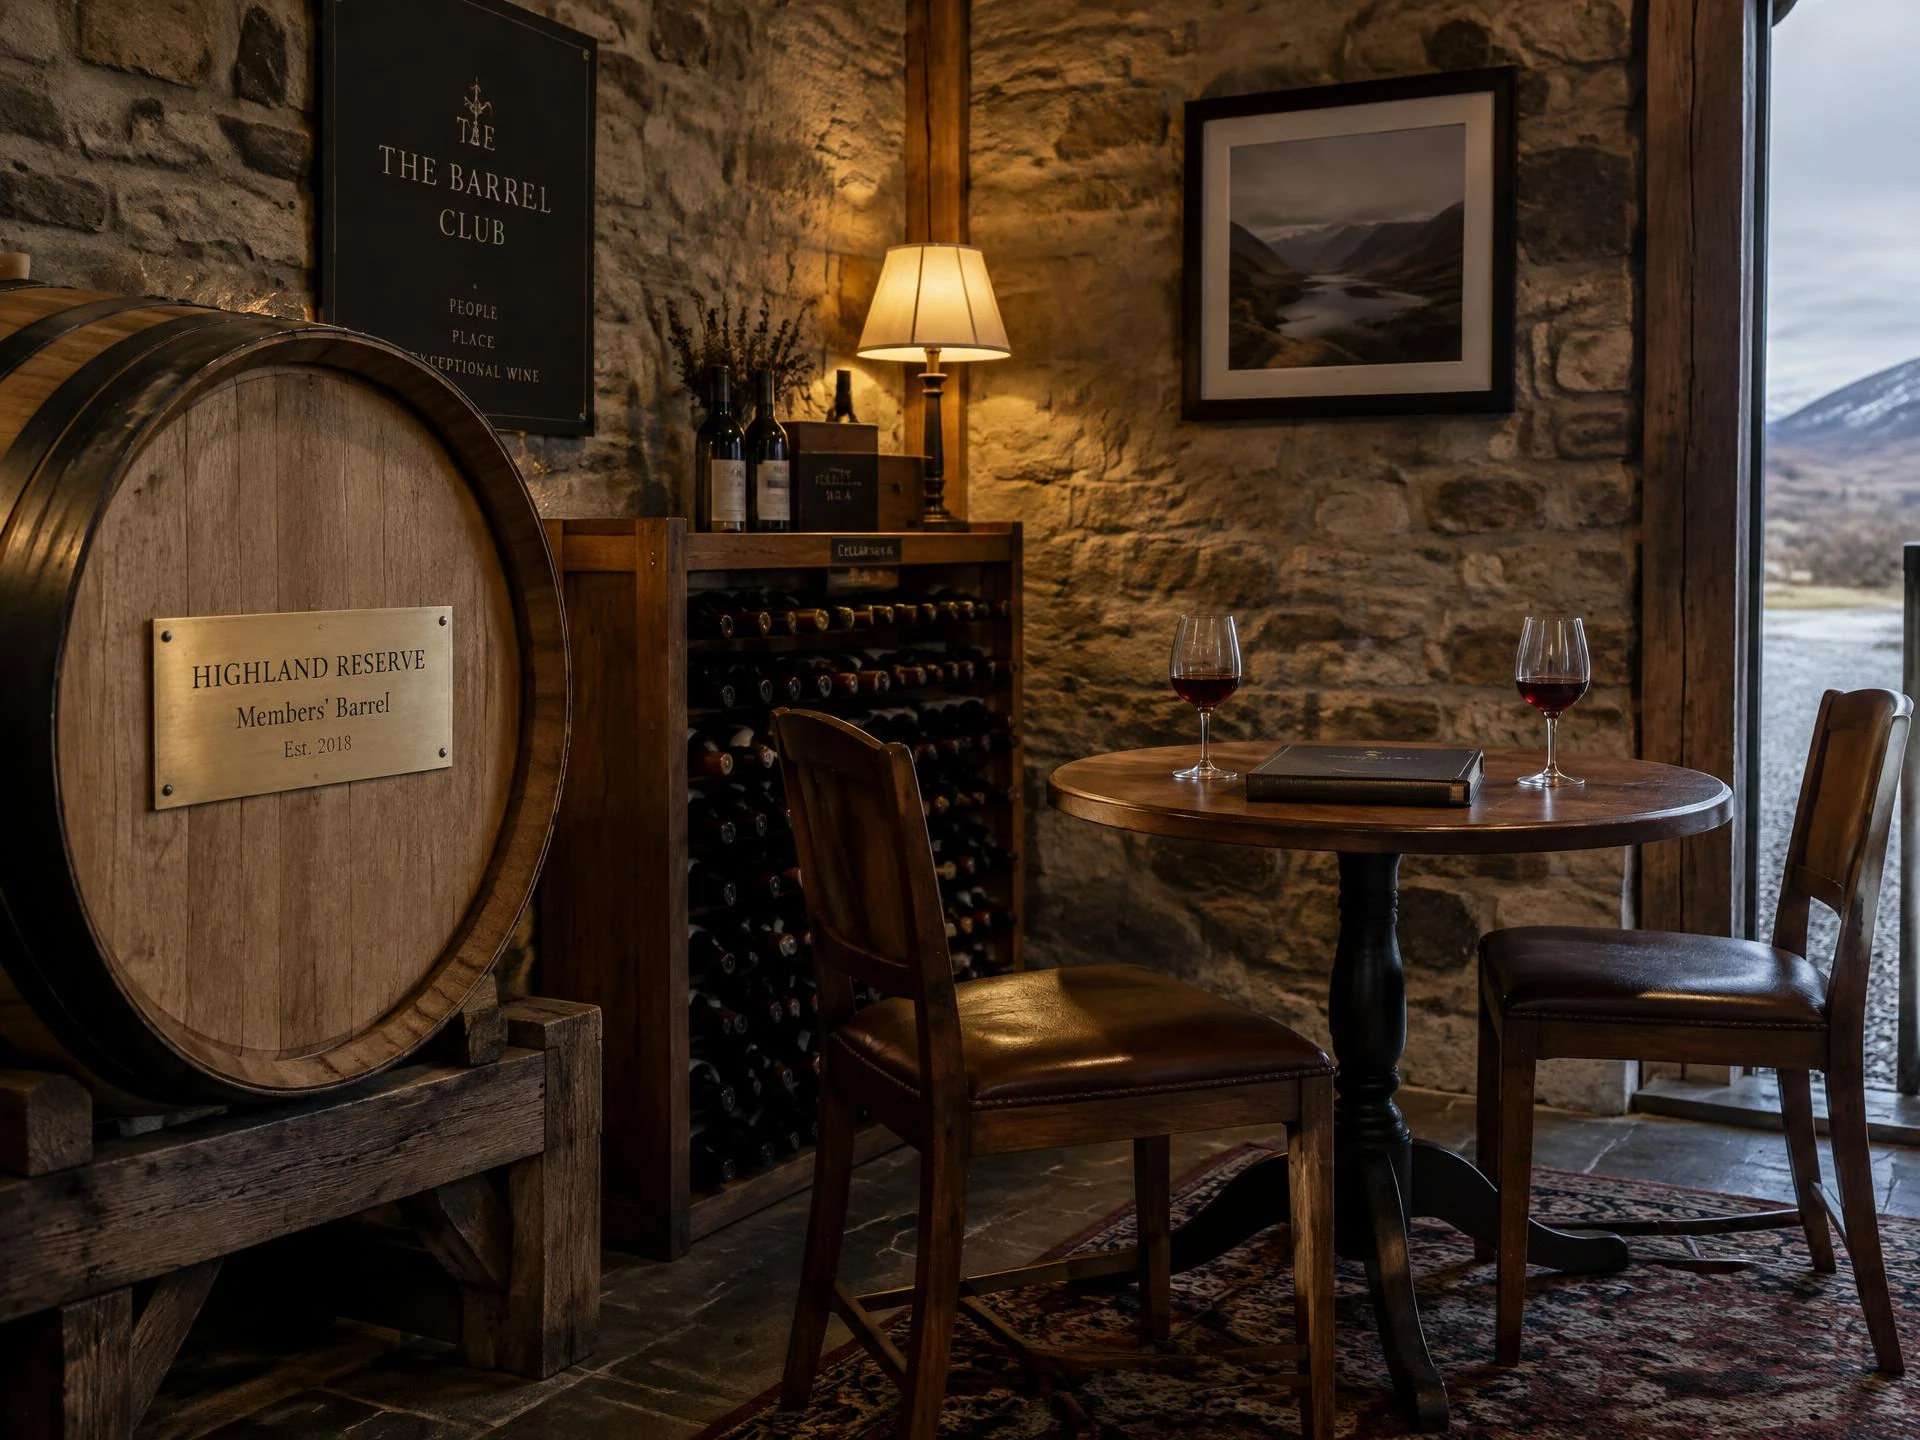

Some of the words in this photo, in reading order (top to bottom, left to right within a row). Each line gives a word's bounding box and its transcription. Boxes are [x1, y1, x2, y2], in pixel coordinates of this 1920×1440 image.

[379, 144, 437, 186] THE
[450, 163, 551, 214] BARREL
[440, 208, 505, 246] CLUB
[449, 298, 498, 320] PEOPLE
[452, 330, 495, 349] PLACE
[506, 367, 540, 383] WINE
[193, 657, 328, 689] HIGHLAND
[336, 650, 426, 677] RESERVE
[236, 698, 329, 729] Members'
[336, 692, 390, 718] Barrel
[285, 740, 312, 759] Est.
[318, 735, 352, 754] 2018
